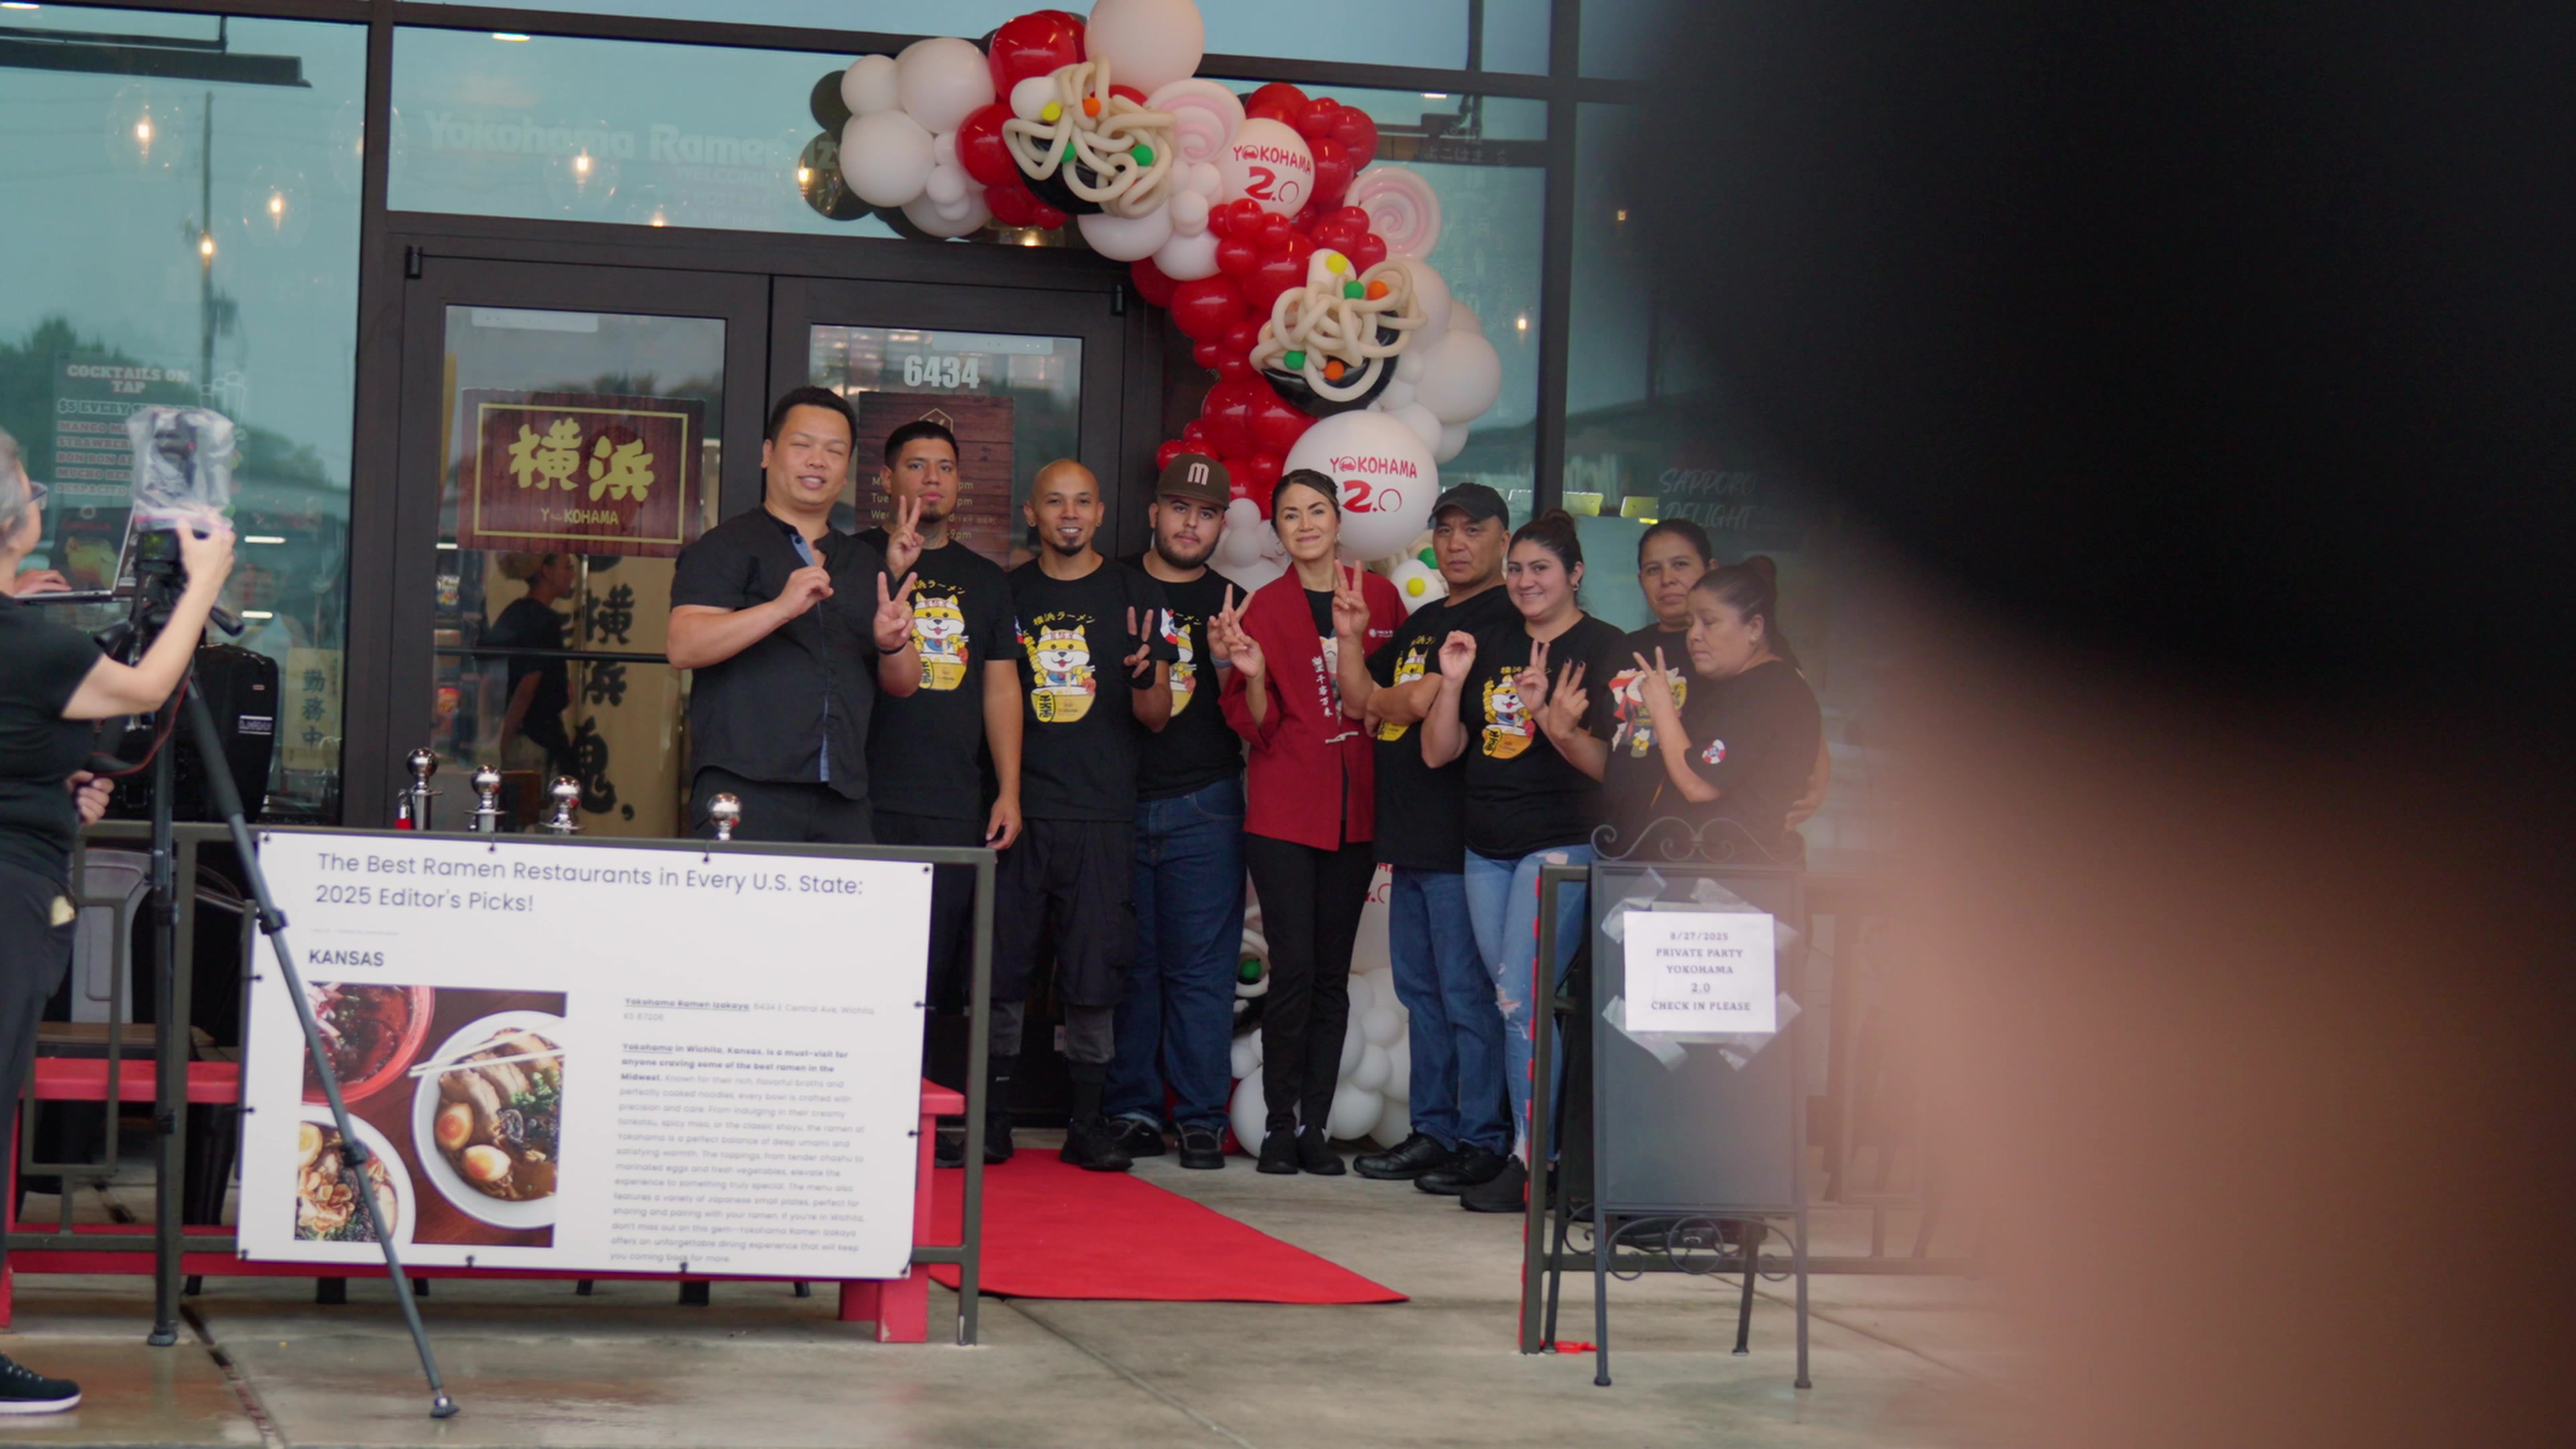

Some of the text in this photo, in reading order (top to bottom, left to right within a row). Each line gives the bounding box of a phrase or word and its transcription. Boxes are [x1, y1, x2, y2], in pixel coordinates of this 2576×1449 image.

[1244, 165, 1300, 203] 2.0
[66, 364, 191, 382] COCKTAILS ON
[904, 354, 979, 389] 6434
[111, 380, 146, 394] TAP
[58, 398, 77, 414] $5
[79, 400, 131, 415] EVERY
[58, 421, 108, 433] MANGO
[57, 436, 133, 450] STRAWBER
[508, 417, 655, 502] 横浜
[56, 467, 104, 480] MUCHO
[1660, 467, 1756, 496] SAPPORO
[1342, 479, 1403, 514] 2.0
[1665, 501, 1758, 531] DELIGHT
[301, 668, 326, 751] 勤務中
[318, 853, 864, 895] The Best Ramen Restaurants in Every U.S. State:
[315, 885, 534, 912] 2025 Editor's Picks!
[1670, 932, 1729, 941] 8/27/2025
[309, 949, 384, 967] KANSAS
[1656, 948, 1743, 958] PRIVATE PARTY
[1666, 965, 1734, 974] YOKOHAMA
[1690, 982, 1711, 994] 2.0
[625, 998, 676, 1008] Yokohama
[677, 1000, 710, 1009] Ramen
[1651, 1000, 1751, 1011] CHECK IN PLEASE
[623, 1042, 674, 1052] Yokohama
[727, 1046, 763, 1057] Kansas,
[784, 1049, 833, 1058] must-visit
[835, 1051, 848, 1059] for
[621, 1059, 657, 1068] anyone
[659, 1059, 695, 1069] craving
[736, 1061, 751, 1069] the
[753, 1062, 773, 1071] best
[819, 1065, 834, 1073] the
[621, 1072, 661, 1081] Midwest.
